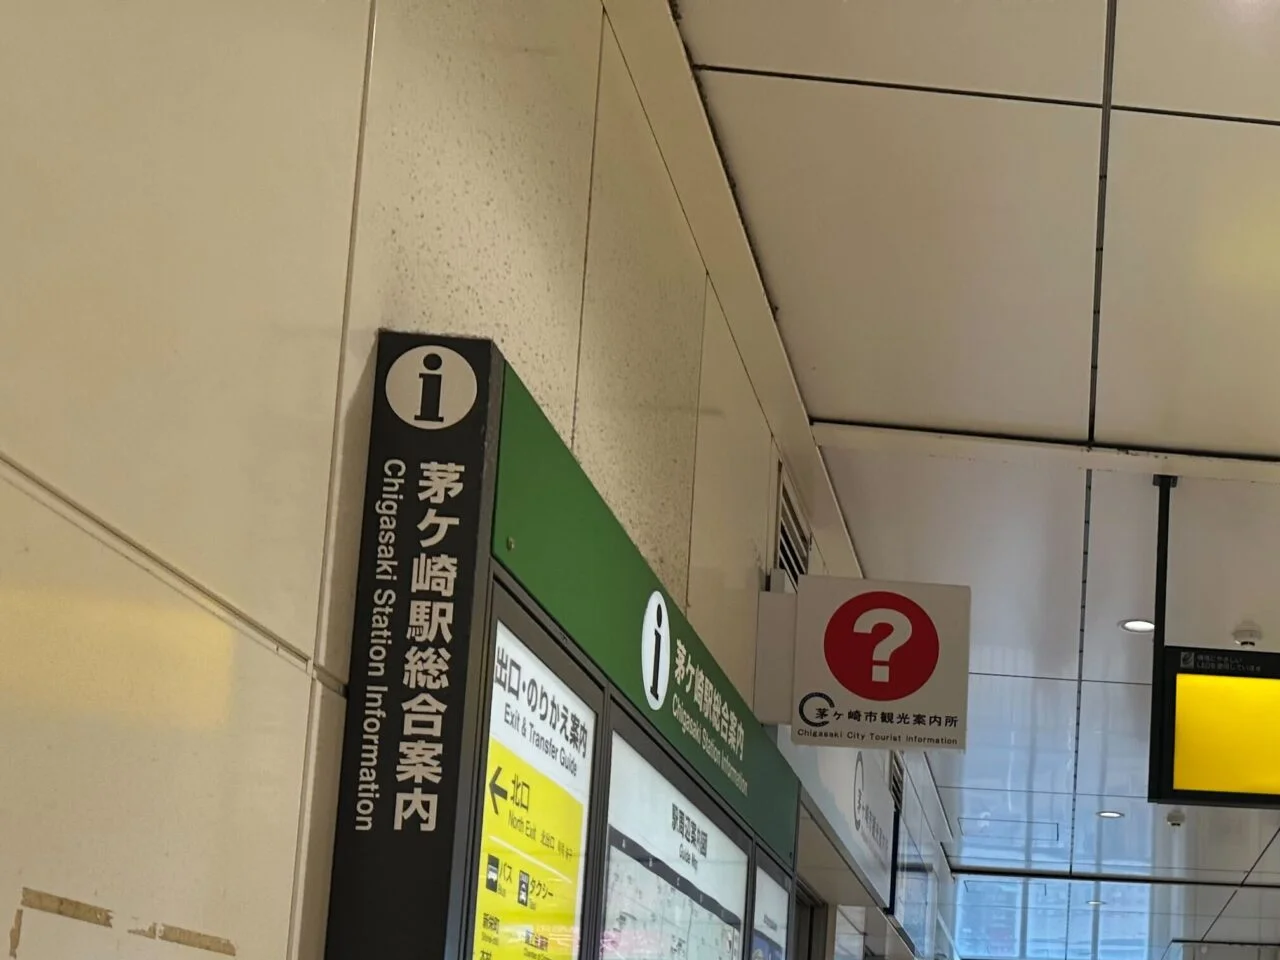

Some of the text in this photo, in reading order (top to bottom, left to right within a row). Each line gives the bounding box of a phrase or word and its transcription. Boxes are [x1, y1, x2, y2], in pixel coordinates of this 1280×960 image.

[355, 458, 407, 831] Chigasaki Station Information
[393, 461, 465, 833] 茅ケ崎駅総合案内
[503, 702, 577, 777] Exit & Transfer Guide
[673, 694, 700, 744] Chigasaki
[797, 729, 843, 739] Chigasaki
[847, 732, 865, 740] City
[870, 733, 901, 741] Tourist
[509, 771, 530, 813] 北口
[507, 809, 536, 841] North Exit
[499, 860, 513, 883] バス
[529, 875, 553, 904] タクシー
